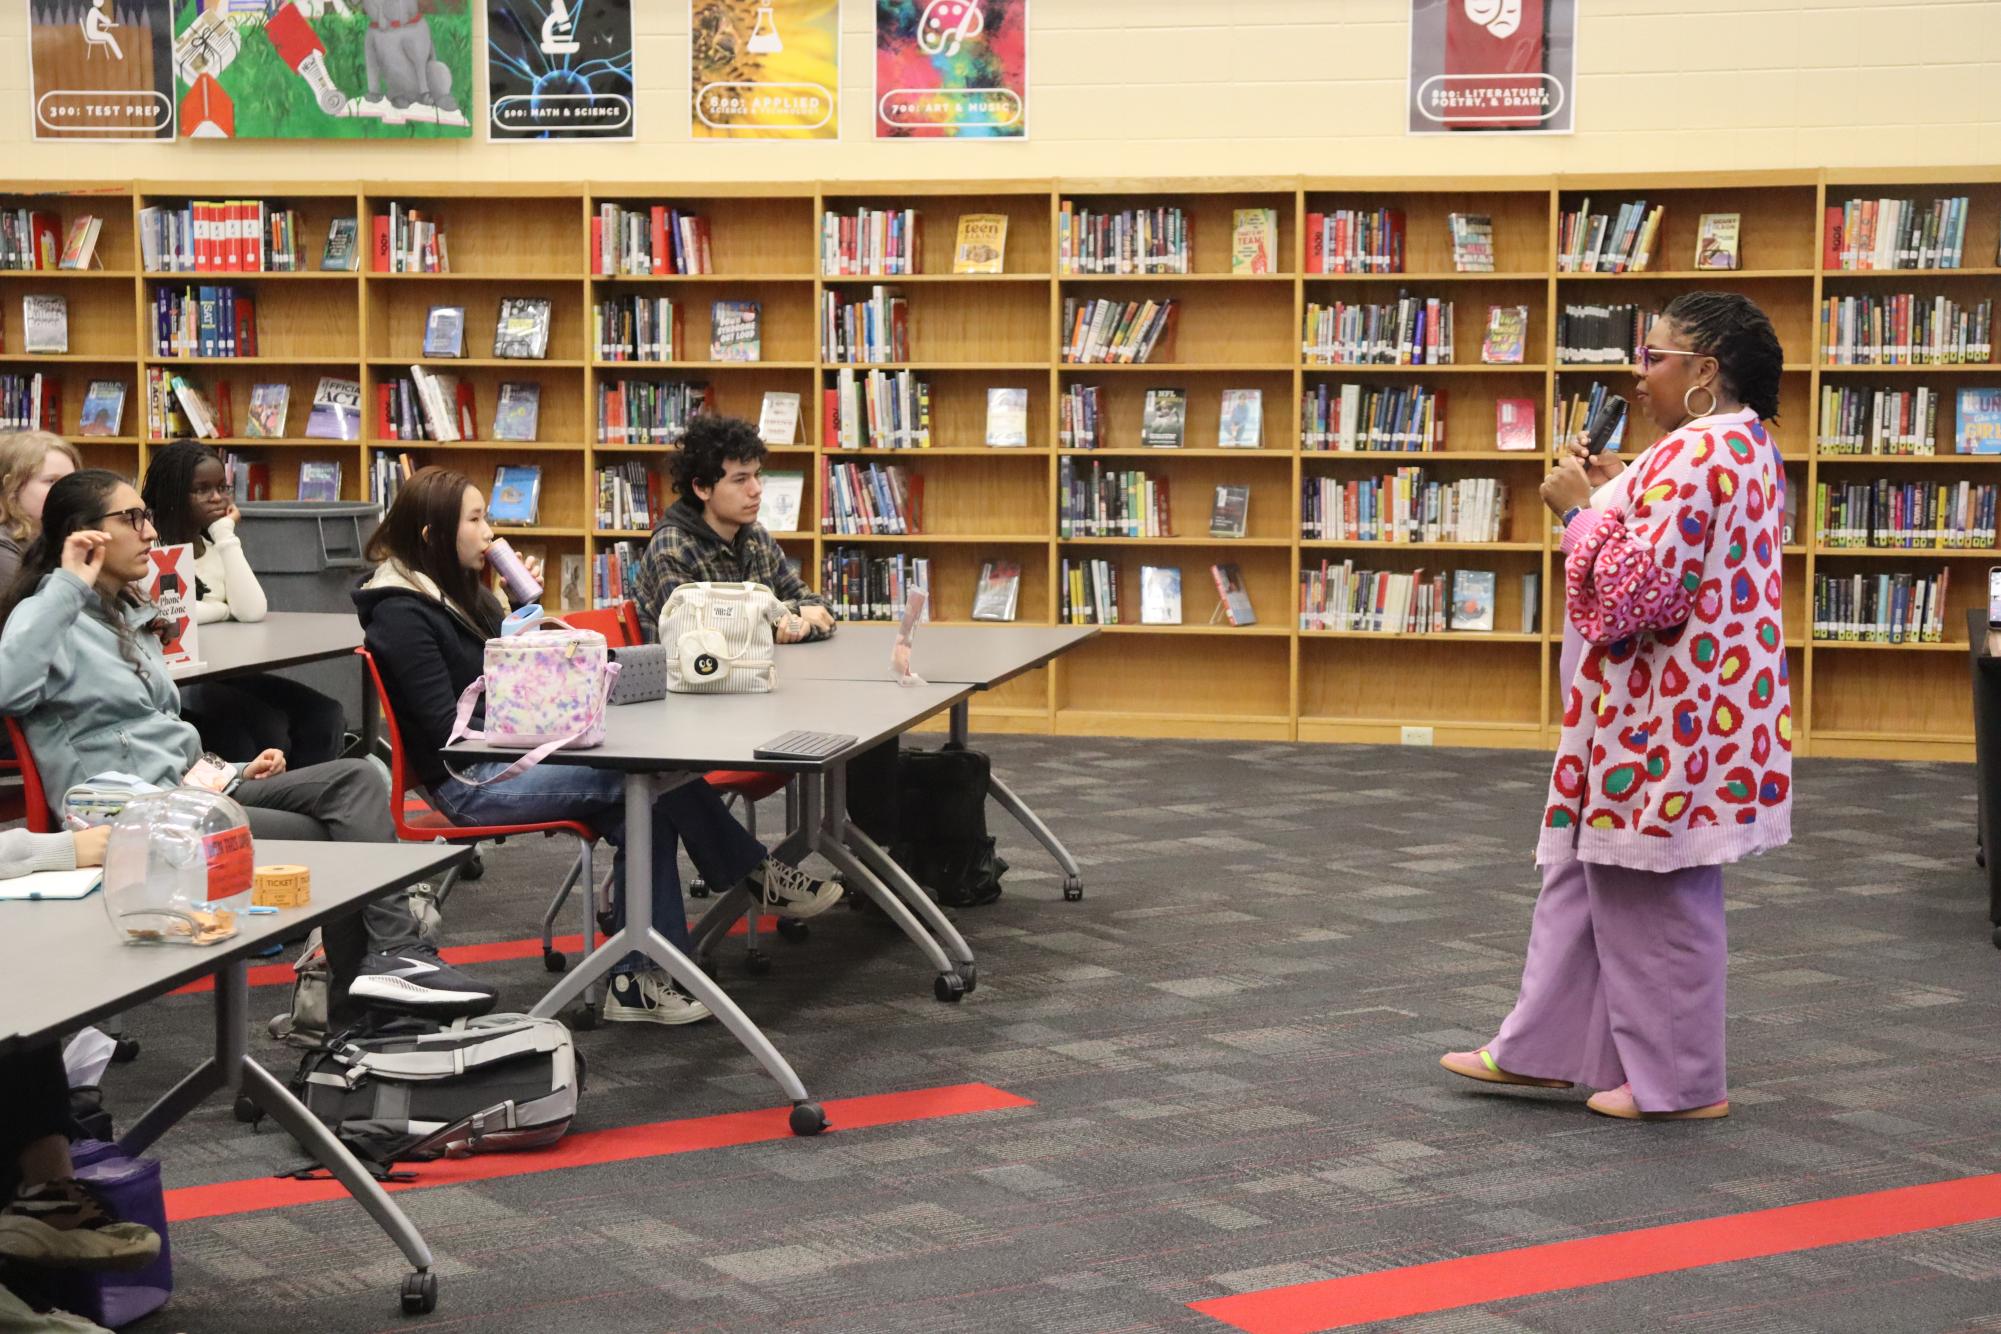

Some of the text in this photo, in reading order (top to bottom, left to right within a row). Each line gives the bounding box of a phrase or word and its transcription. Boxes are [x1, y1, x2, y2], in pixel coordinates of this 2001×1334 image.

[1465, 88, 1550, 98] LITERATURE,
[711, 96, 820, 108] 600: APPLIED
[1432, 97, 1550, 107] POETRY, & DRAMA
[50, 105, 161, 118] 300: TEST PREP
[504, 107, 620, 119] 500: MATH & SCIENCE
[892, 103, 1010, 114] 700: ART & MUSIC
[203, 303, 213, 324] SAT
[329, 382, 360, 394] FFICIA
[318, 391, 359, 406] ACT
[160, 596, 180, 606] Phone
[159, 605, 186, 616] ree Zone
[266, 879, 293, 887] TICKET
